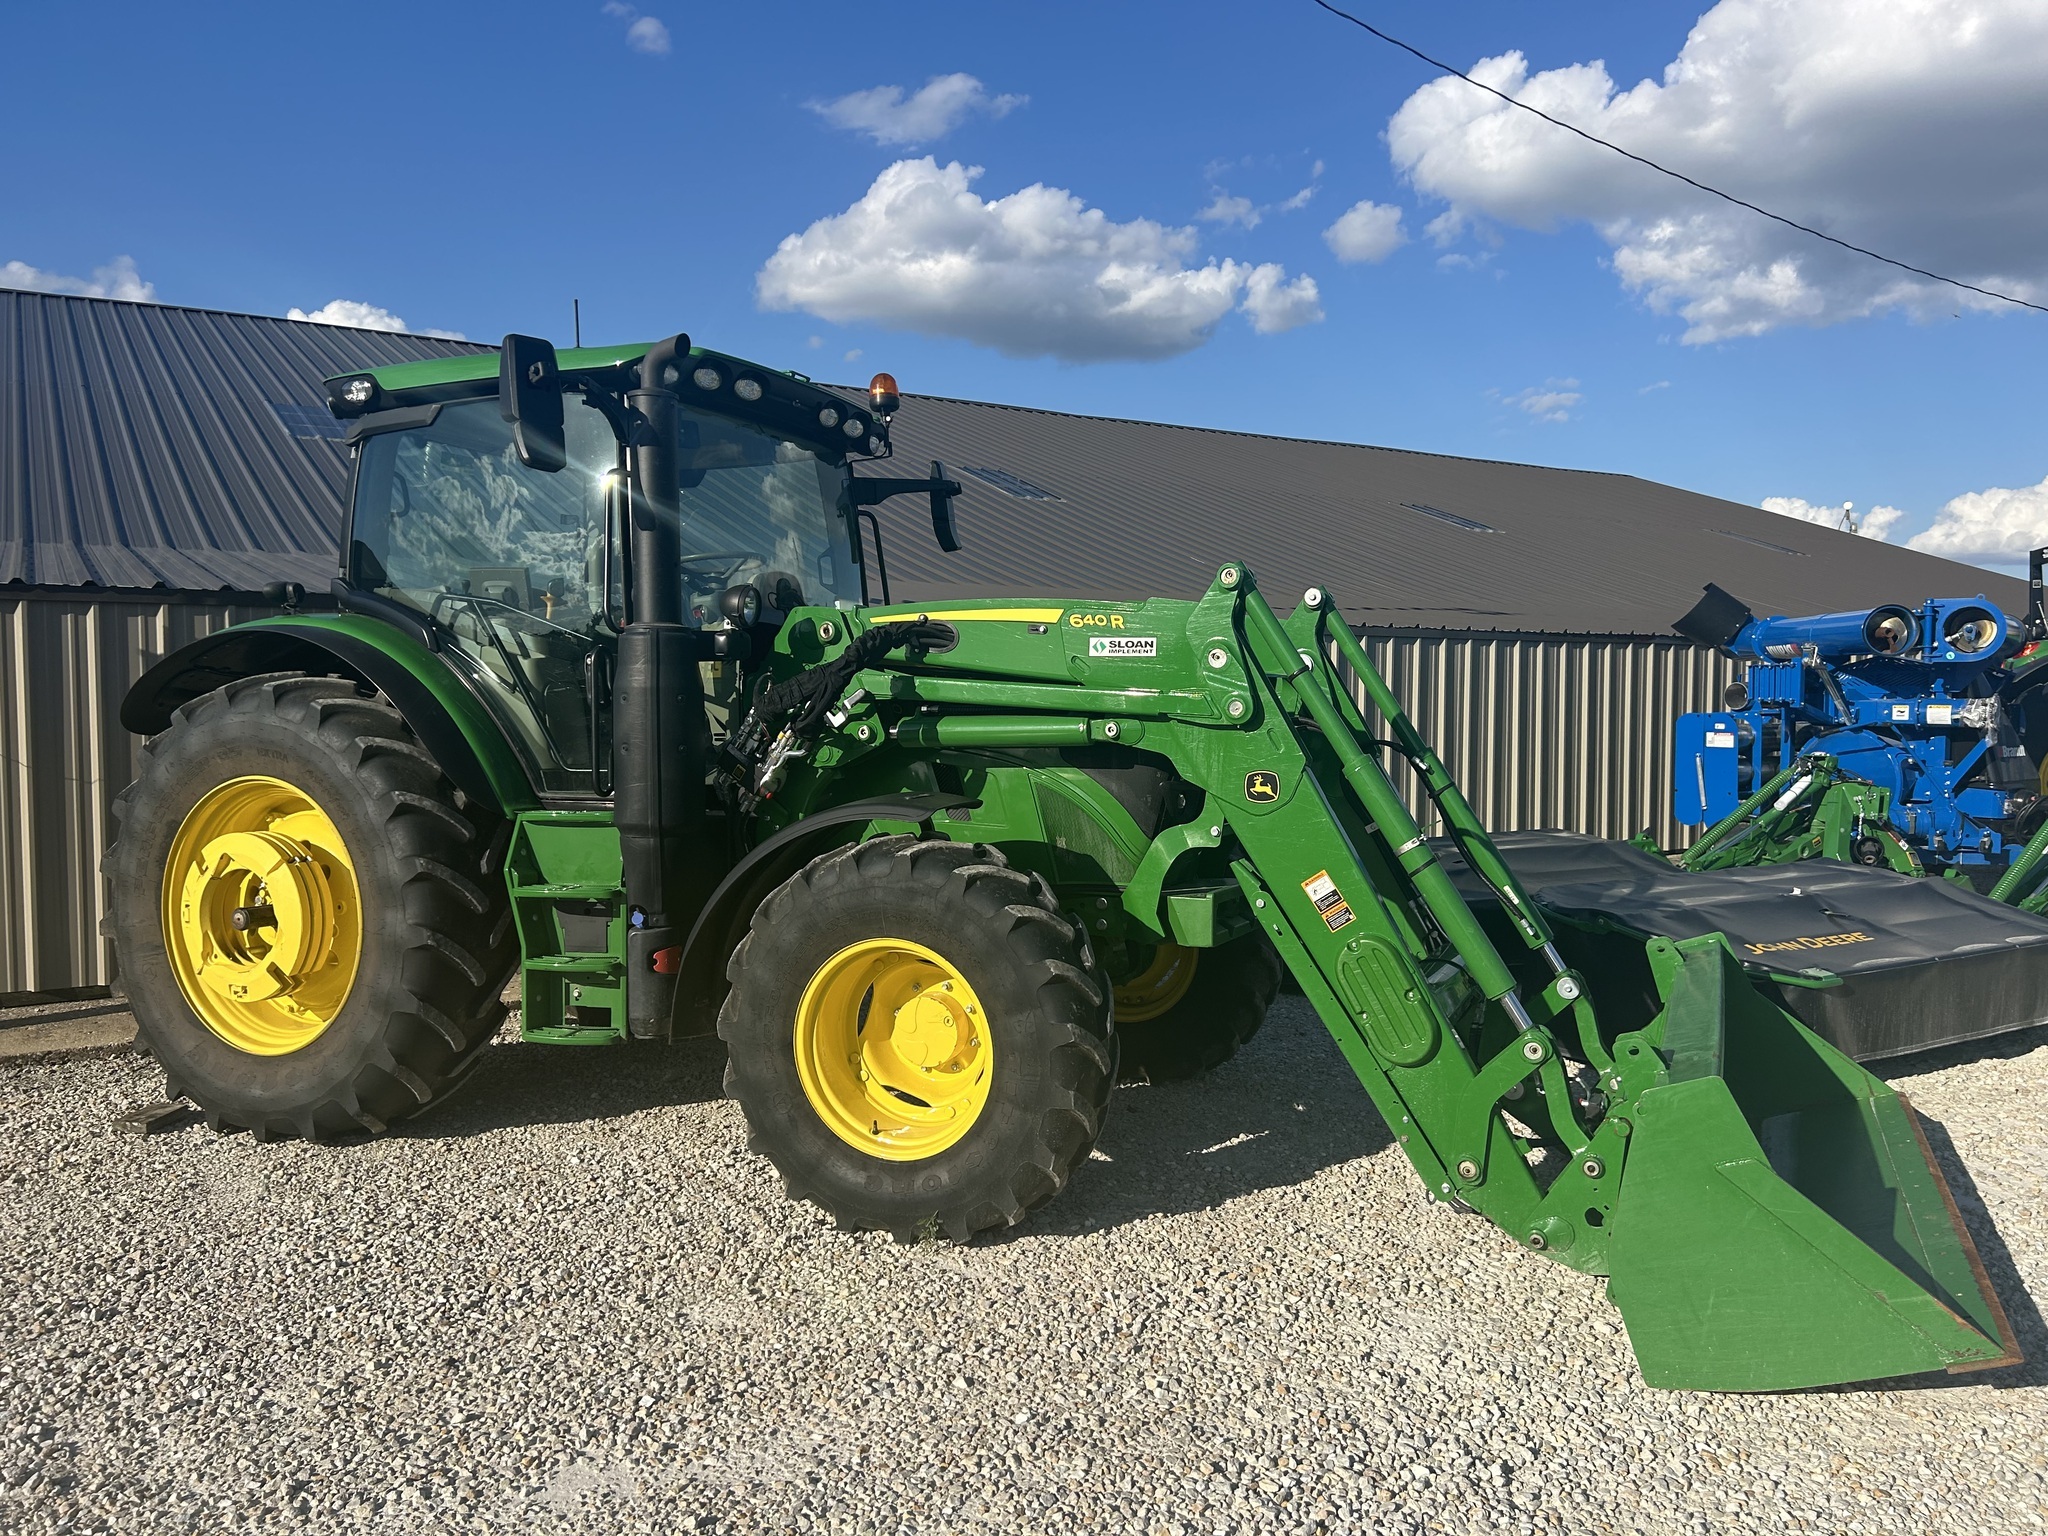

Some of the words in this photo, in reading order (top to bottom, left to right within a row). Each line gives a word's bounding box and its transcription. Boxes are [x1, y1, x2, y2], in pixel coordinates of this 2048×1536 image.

[1108, 640, 1154, 649] SLOAN
[1744, 940, 1806, 955] JOHN
[1797, 932, 1875, 950] DEERE
